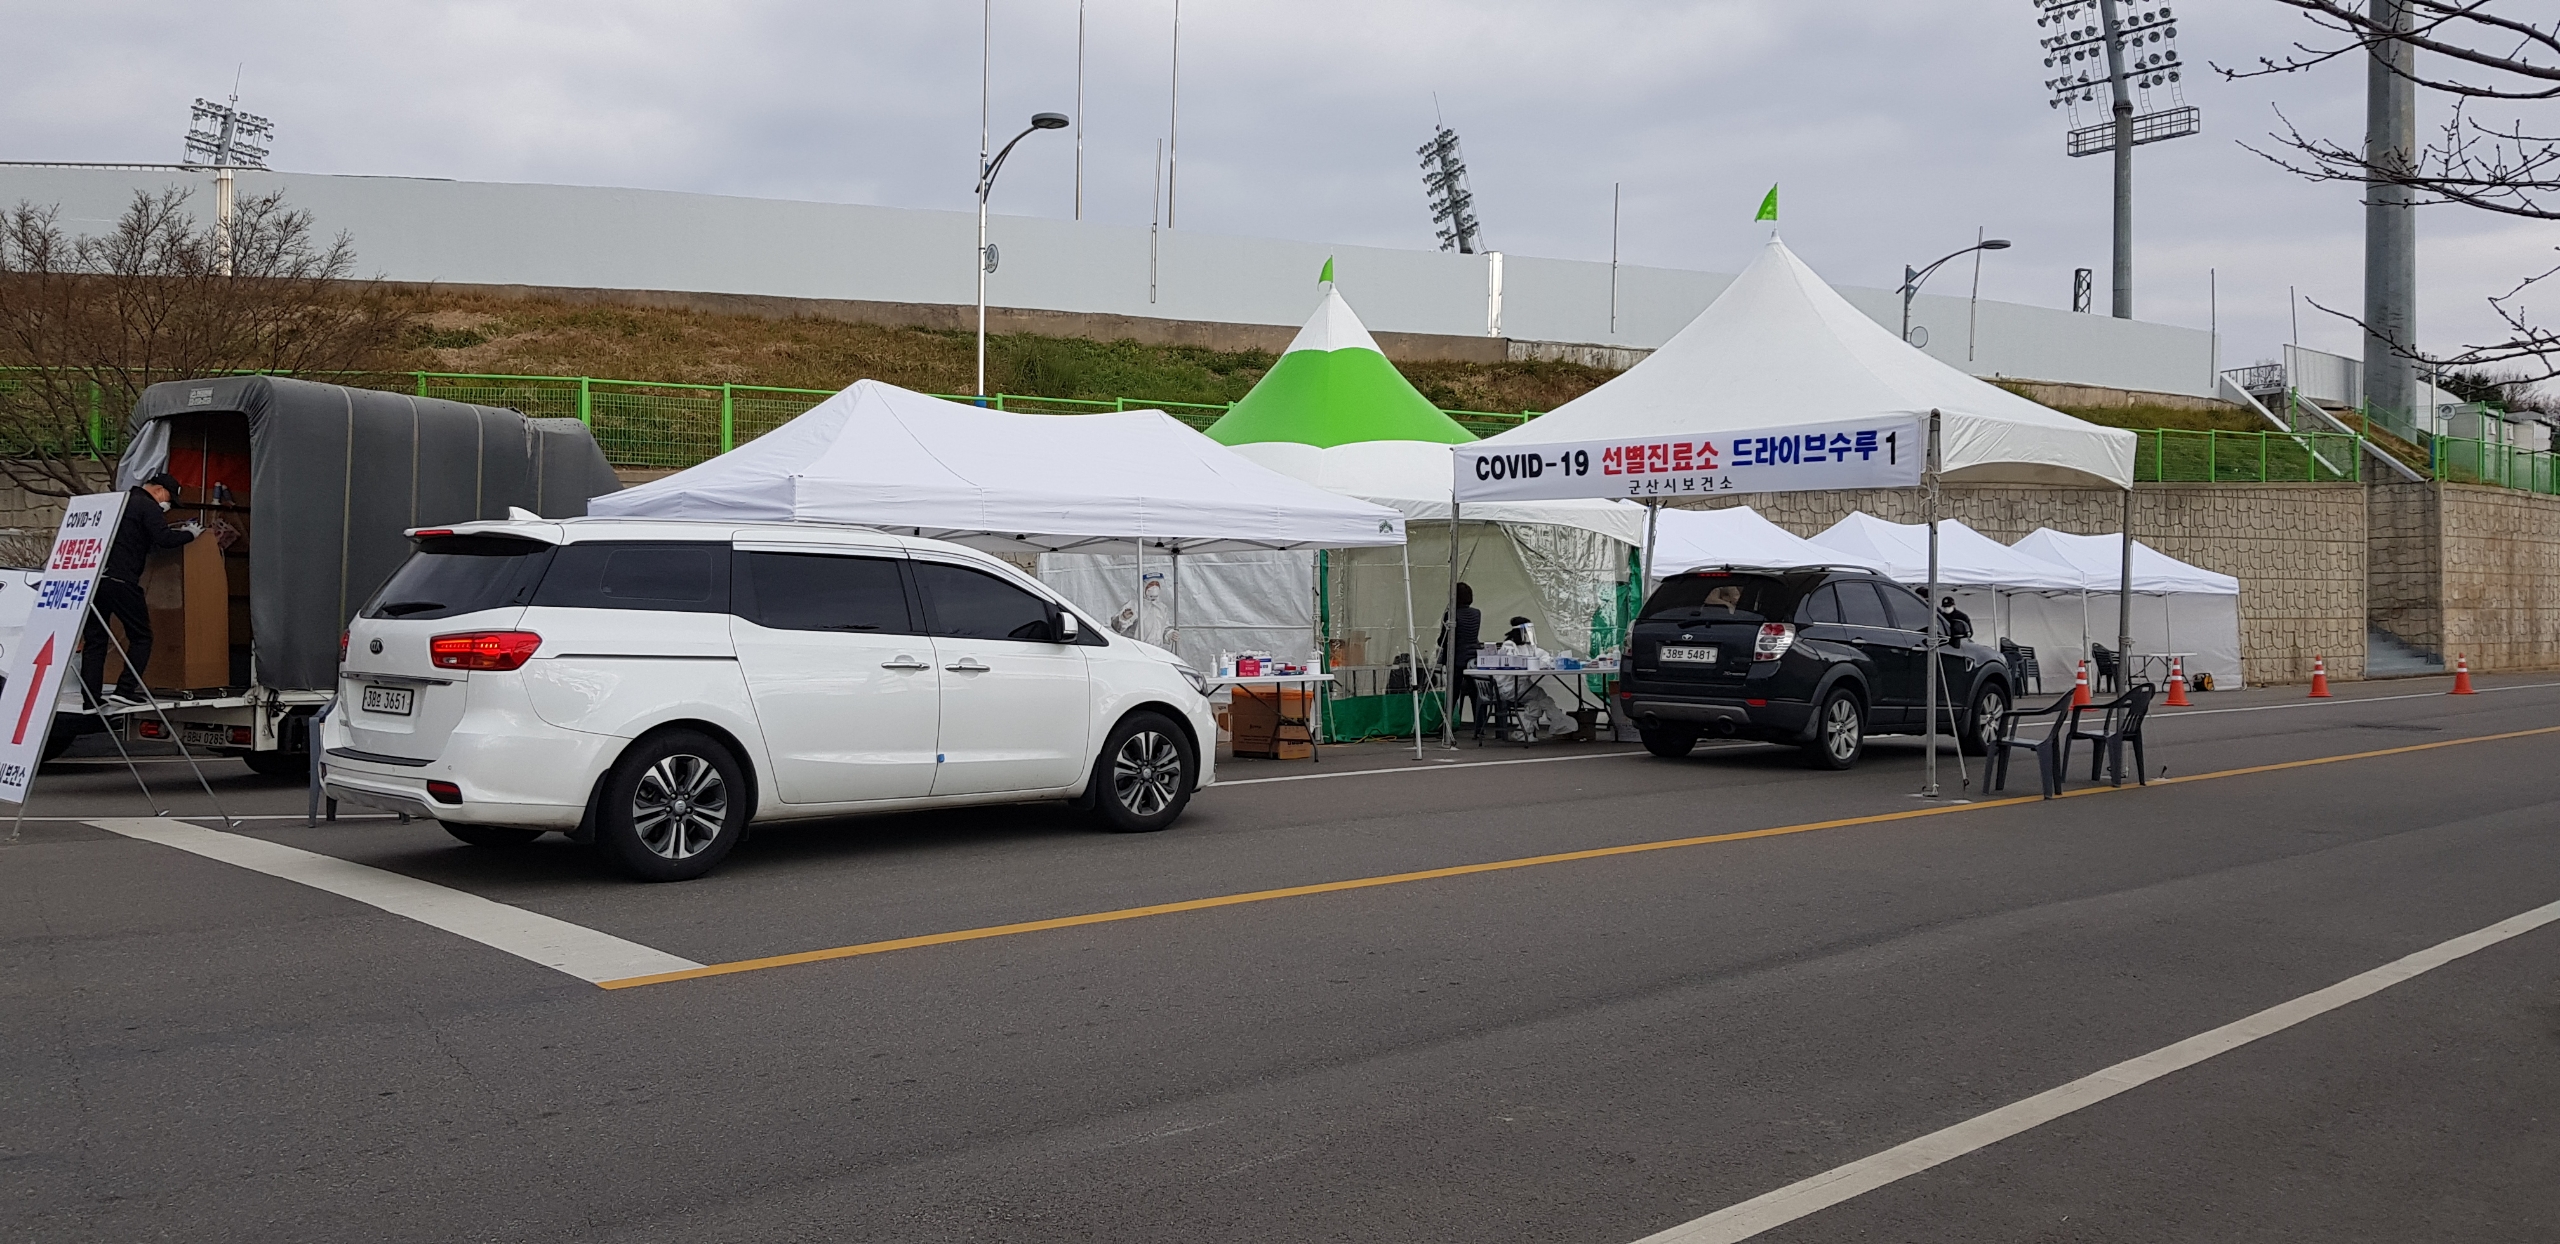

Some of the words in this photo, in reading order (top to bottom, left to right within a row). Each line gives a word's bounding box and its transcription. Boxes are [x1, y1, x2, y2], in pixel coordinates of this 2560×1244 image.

[1475, 449, 1590, 481] COVID-19
[1601, 441, 1719, 476] 선별진료소
[1731, 430, 1879, 467] 드라이브수루
[1885, 431, 1897, 466] 1
[1628, 475, 1733, 495] 군산시보건소
[66, 510, 103, 529] COVID-19
[52, 538, 103, 570] 선별진료소
[37, 579, 90, 611] 드라이브수루
[1665, 648, 1684, 659] 38보
[1686, 649, 1711, 660] 5481
[384, 691, 406, 711] 3651
[203, 732, 225, 745] 0285
